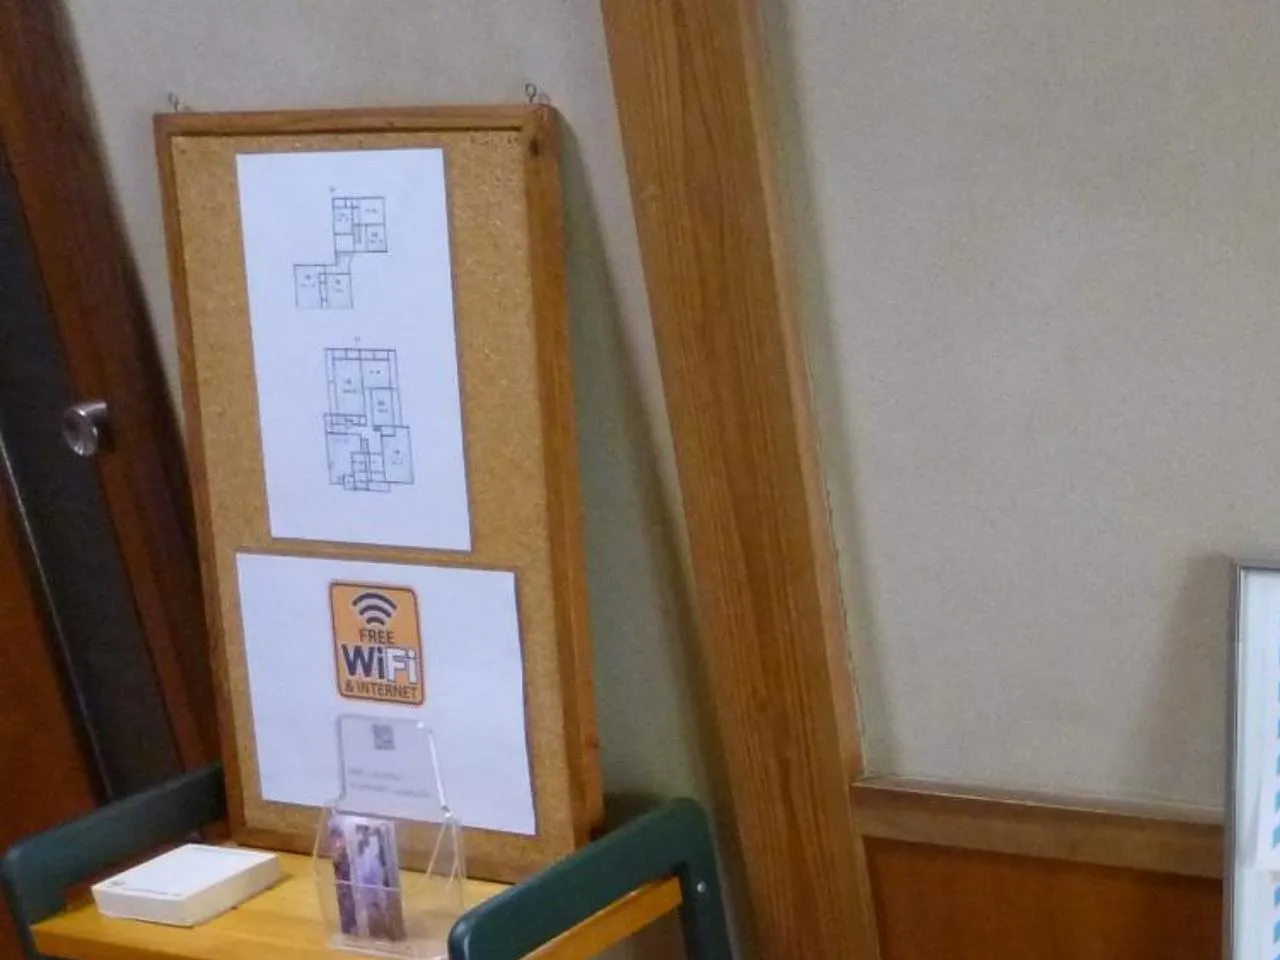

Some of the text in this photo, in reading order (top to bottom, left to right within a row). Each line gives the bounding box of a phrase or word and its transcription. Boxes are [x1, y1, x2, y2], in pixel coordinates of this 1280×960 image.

[359, 629, 395, 644] FREE
[341, 643, 418, 685] WiFi
[357, 682, 418, 698] INTERNET
